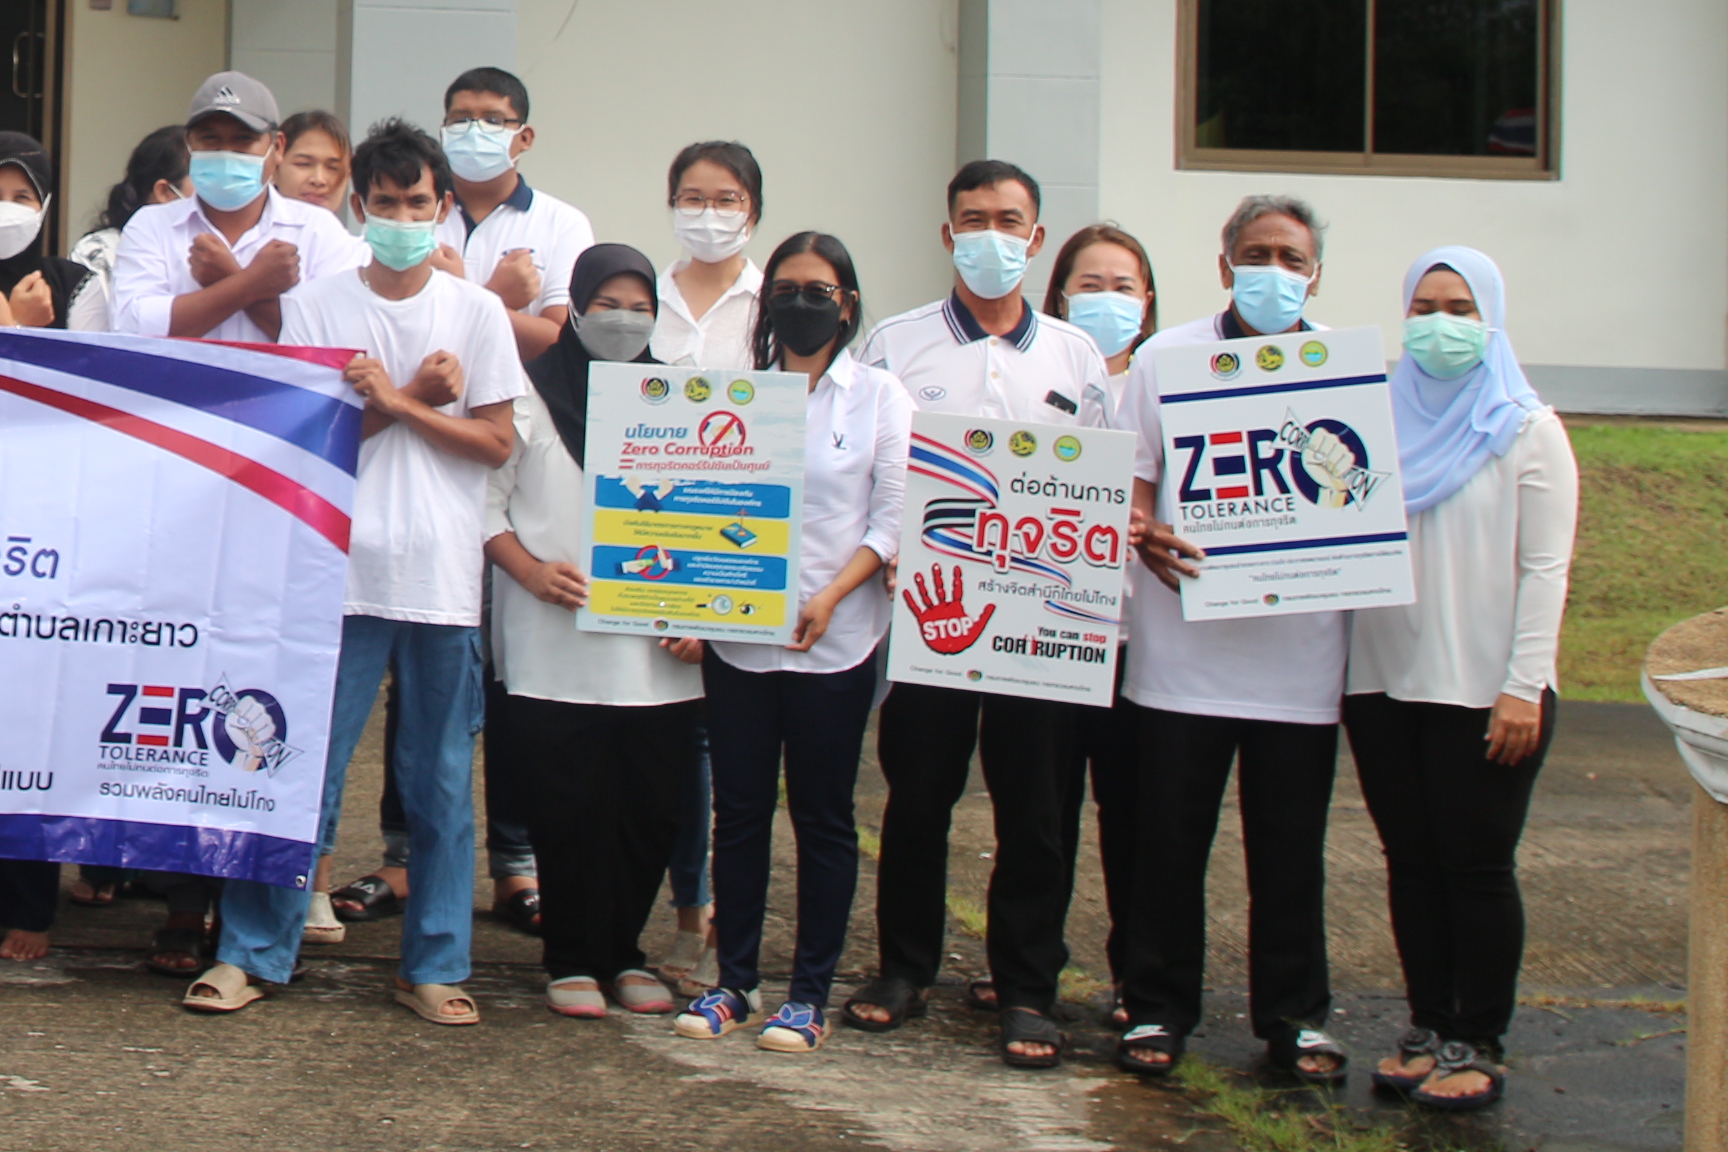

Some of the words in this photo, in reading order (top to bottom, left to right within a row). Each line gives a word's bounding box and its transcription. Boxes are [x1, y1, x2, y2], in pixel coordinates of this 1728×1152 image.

[625, 423, 688, 439] นโยบาย
[621, 442, 659, 456] Zero
[663, 442, 754, 459] Corruption
[1010, 472, 1125, 504] ต่อต้านการ
[1179, 497, 1296, 522] TOLERANCE
[975, 507, 1120, 569] ทุจริต
[923, 617, 974, 641] STOP
[1038, 627, 1056, 638] You
[1060, 630, 1079, 641] can
[1083, 632, 1106, 644] stop
[99, 745, 209, 766] TOLERANCE
[99, 782, 275, 812] รวมพลังคนไทยไม่โกง
